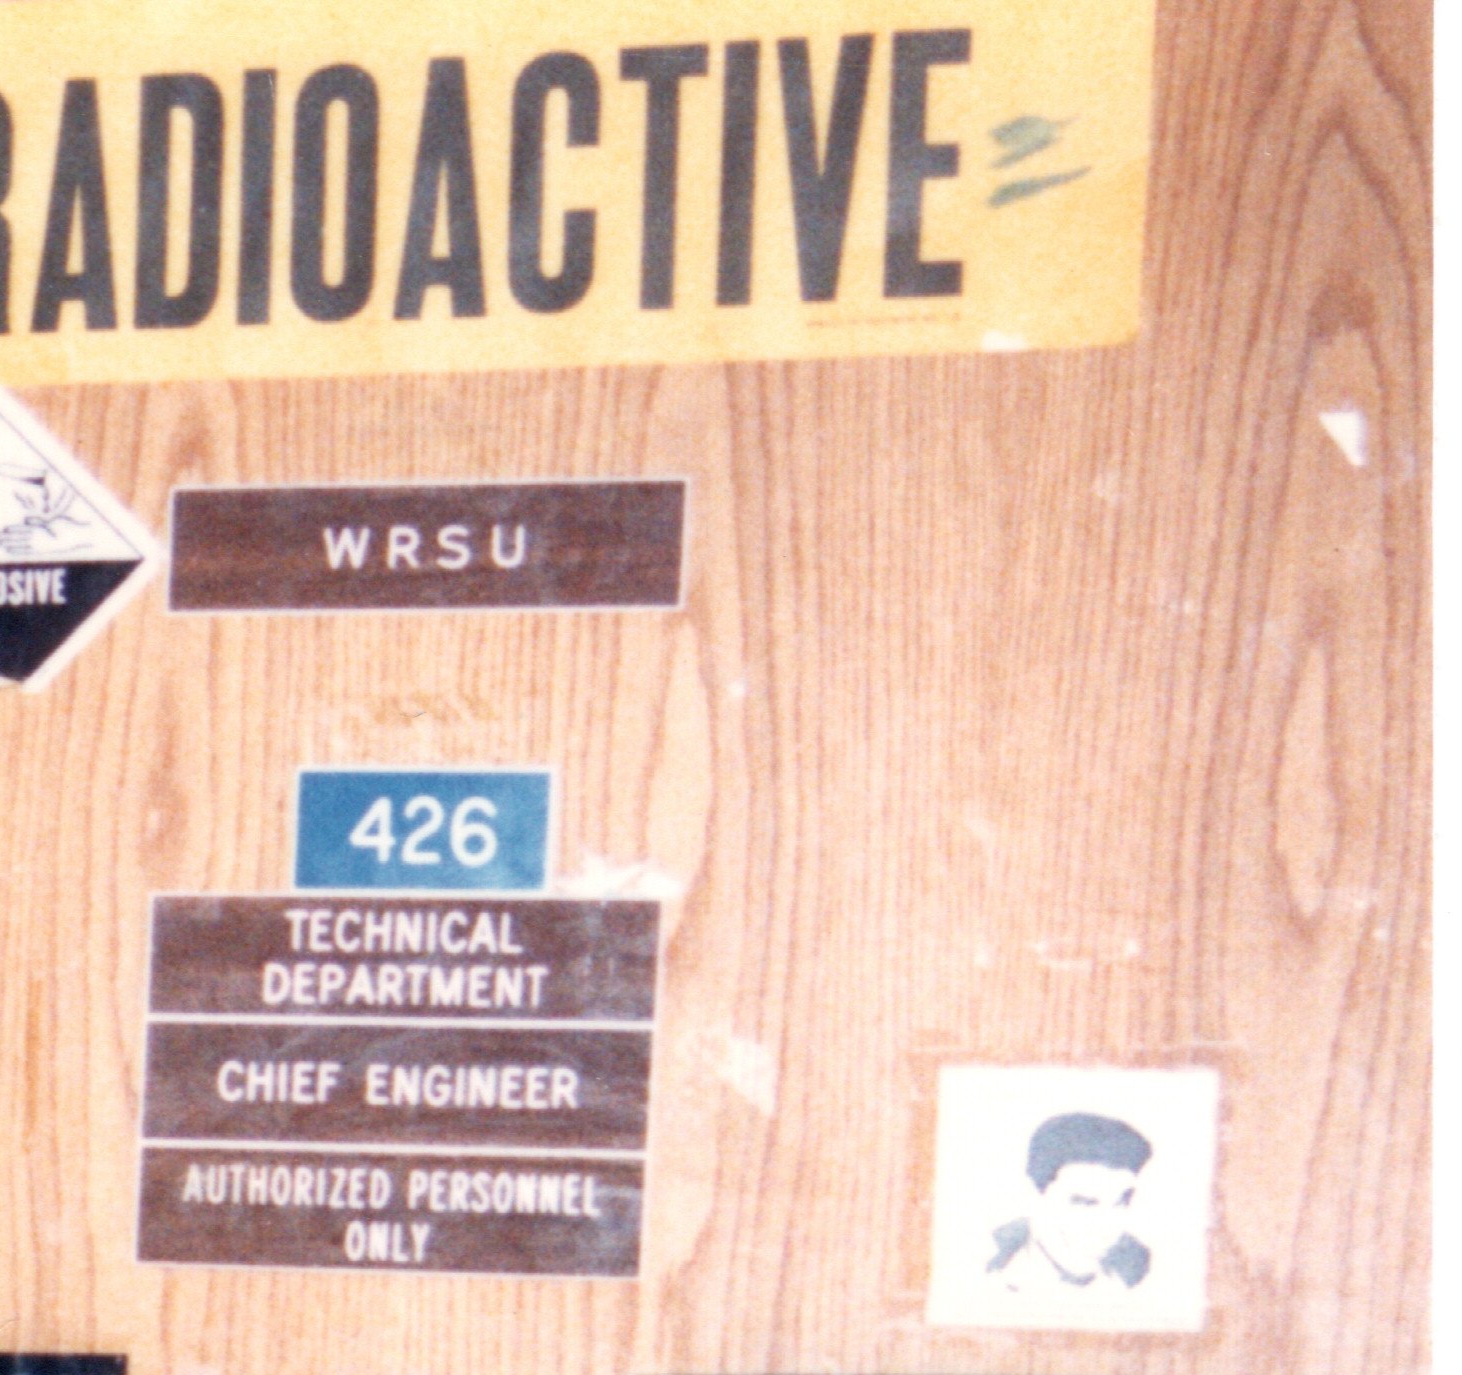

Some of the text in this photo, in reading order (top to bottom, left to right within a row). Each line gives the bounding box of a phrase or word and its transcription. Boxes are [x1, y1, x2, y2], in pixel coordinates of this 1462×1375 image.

[322, 524, 530, 572] WRSU
[348, 795, 499, 868] 426
[285, 908, 523, 955] TECHNICAL
[261, 962, 550, 1009] DEPARTMENT
[217, 1060, 580, 1110] CHIEF ENGINEER
[182, 1163, 603, 1218] AUTHORIZED PERSONNEL
[343, 1222, 431, 1263] ONLY
